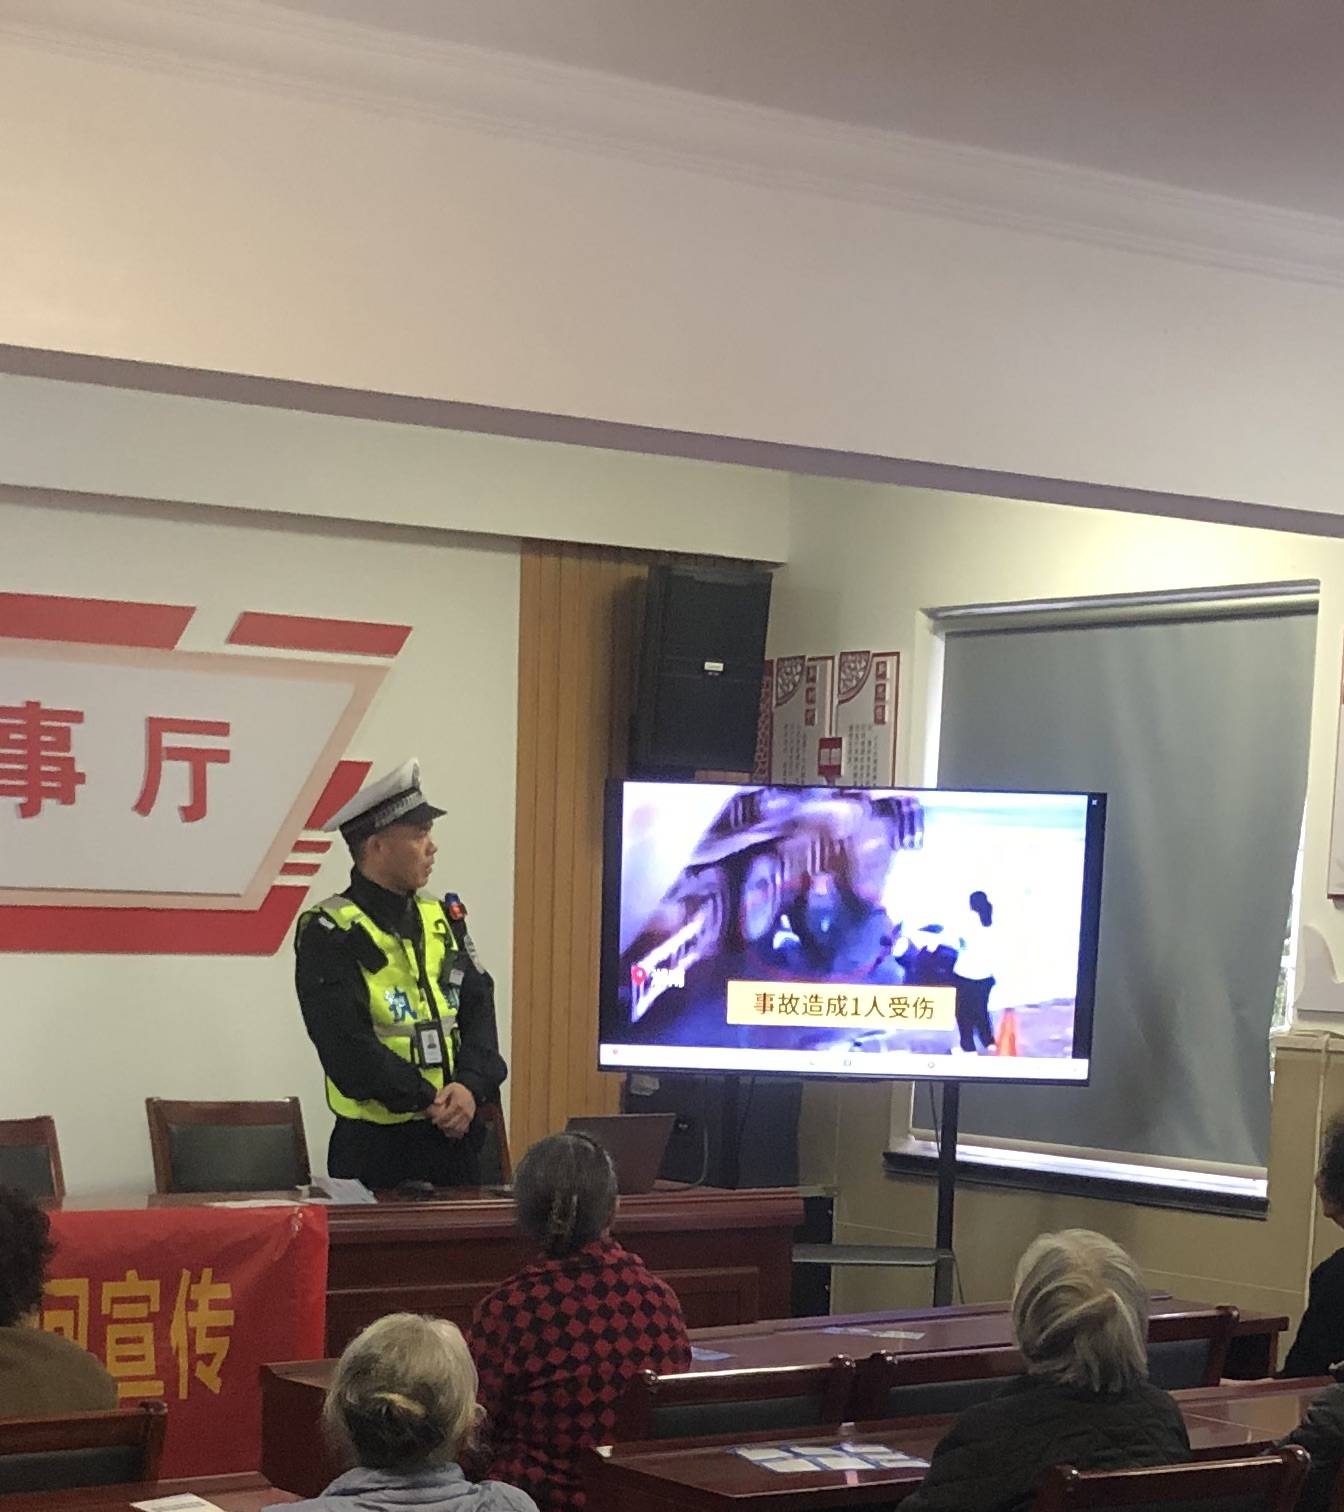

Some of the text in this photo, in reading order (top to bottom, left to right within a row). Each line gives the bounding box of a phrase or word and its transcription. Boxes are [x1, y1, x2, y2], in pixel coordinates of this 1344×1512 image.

[753, 991, 935, 1020] 事故造成1人受伤
